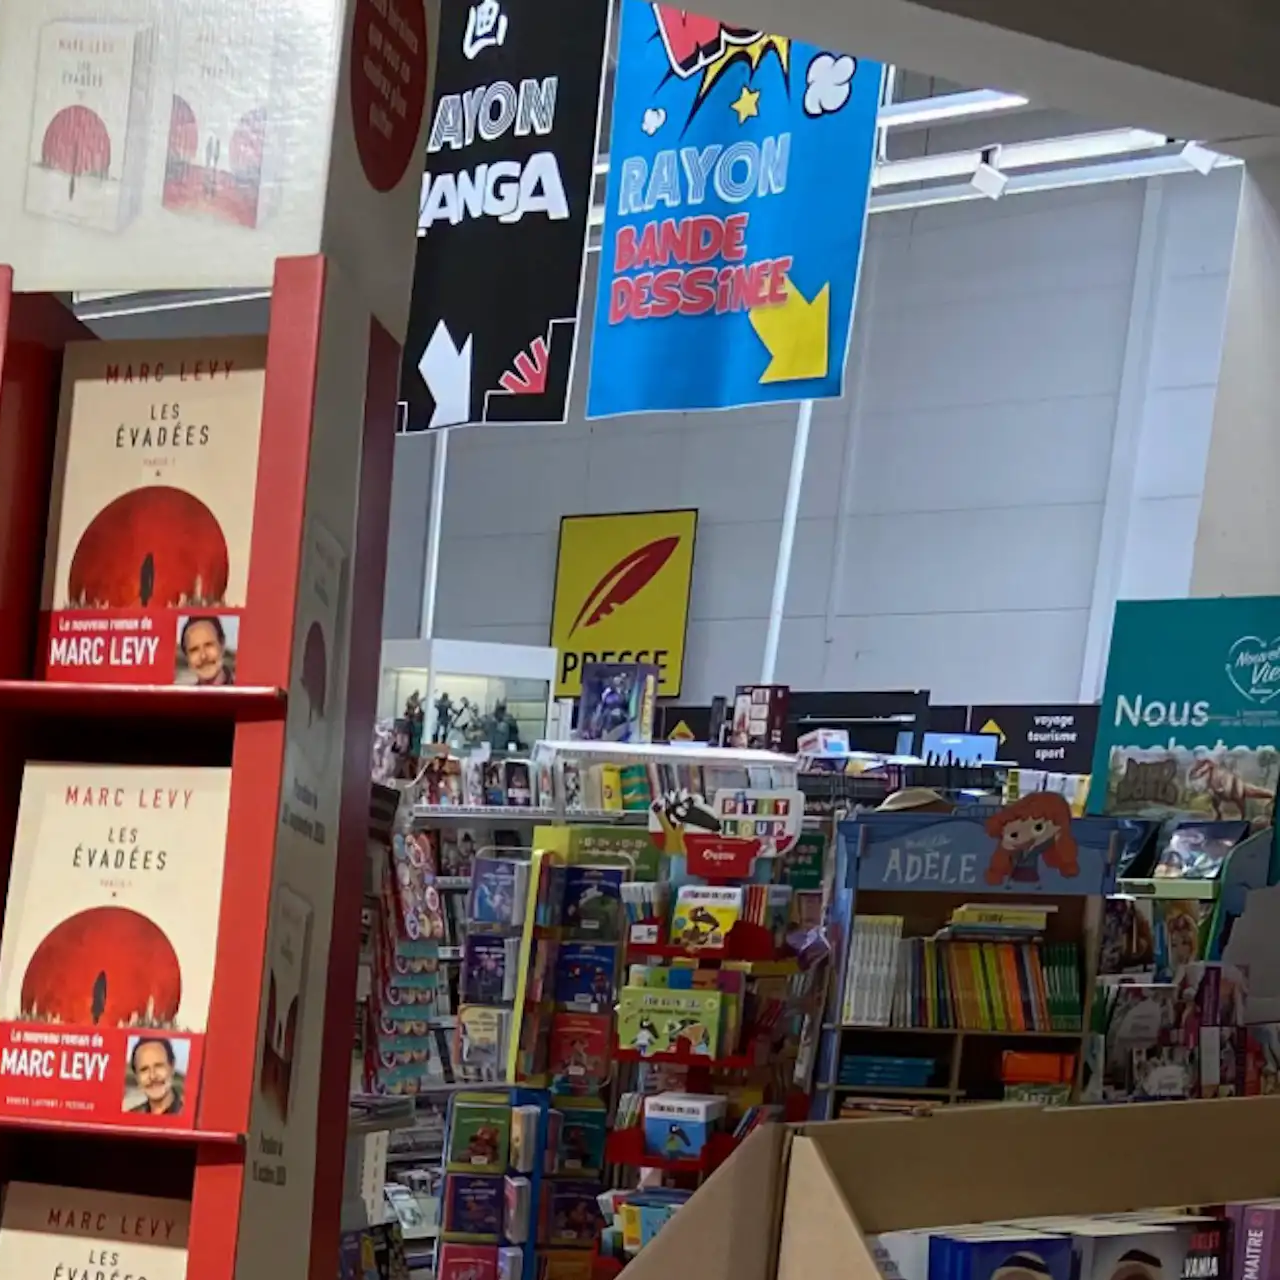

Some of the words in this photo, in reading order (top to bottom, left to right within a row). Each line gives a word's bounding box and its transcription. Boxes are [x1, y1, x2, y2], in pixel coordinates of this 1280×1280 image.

[617, 133, 791, 215] RAYON
[614, 212, 749, 274] BANDE
[106, 361, 166, 384] MARC
[179, 360, 235, 381] LEVY
[150, 403, 181, 421] LES
[115, 421, 210, 449] ÉVADÉES
[50, 637, 104, 666] MARC
[109, 636, 160, 667] LEVY
[1114, 694, 1210, 727] Nous
[1027, 730, 1078, 743] tourisme
[1034, 747, 1066, 761] sport
[65, 786, 125, 809] MARC
[138, 788, 196, 811] LEVY
[107, 826, 140, 845] LES
[723, 820, 787, 838] LOUP
[72, 843, 169, 873] ÉVADÉES
[0, 1049, 55, 1079] MARC
[59, 1052, 110, 1082] LEVY
[48, 1206, 108, 1232] MARC
[120, 1216, 177, 1241] LEVY
[88, 1250, 120, 1267] LES
[1180, 1256, 1219, 1278] VANIA
